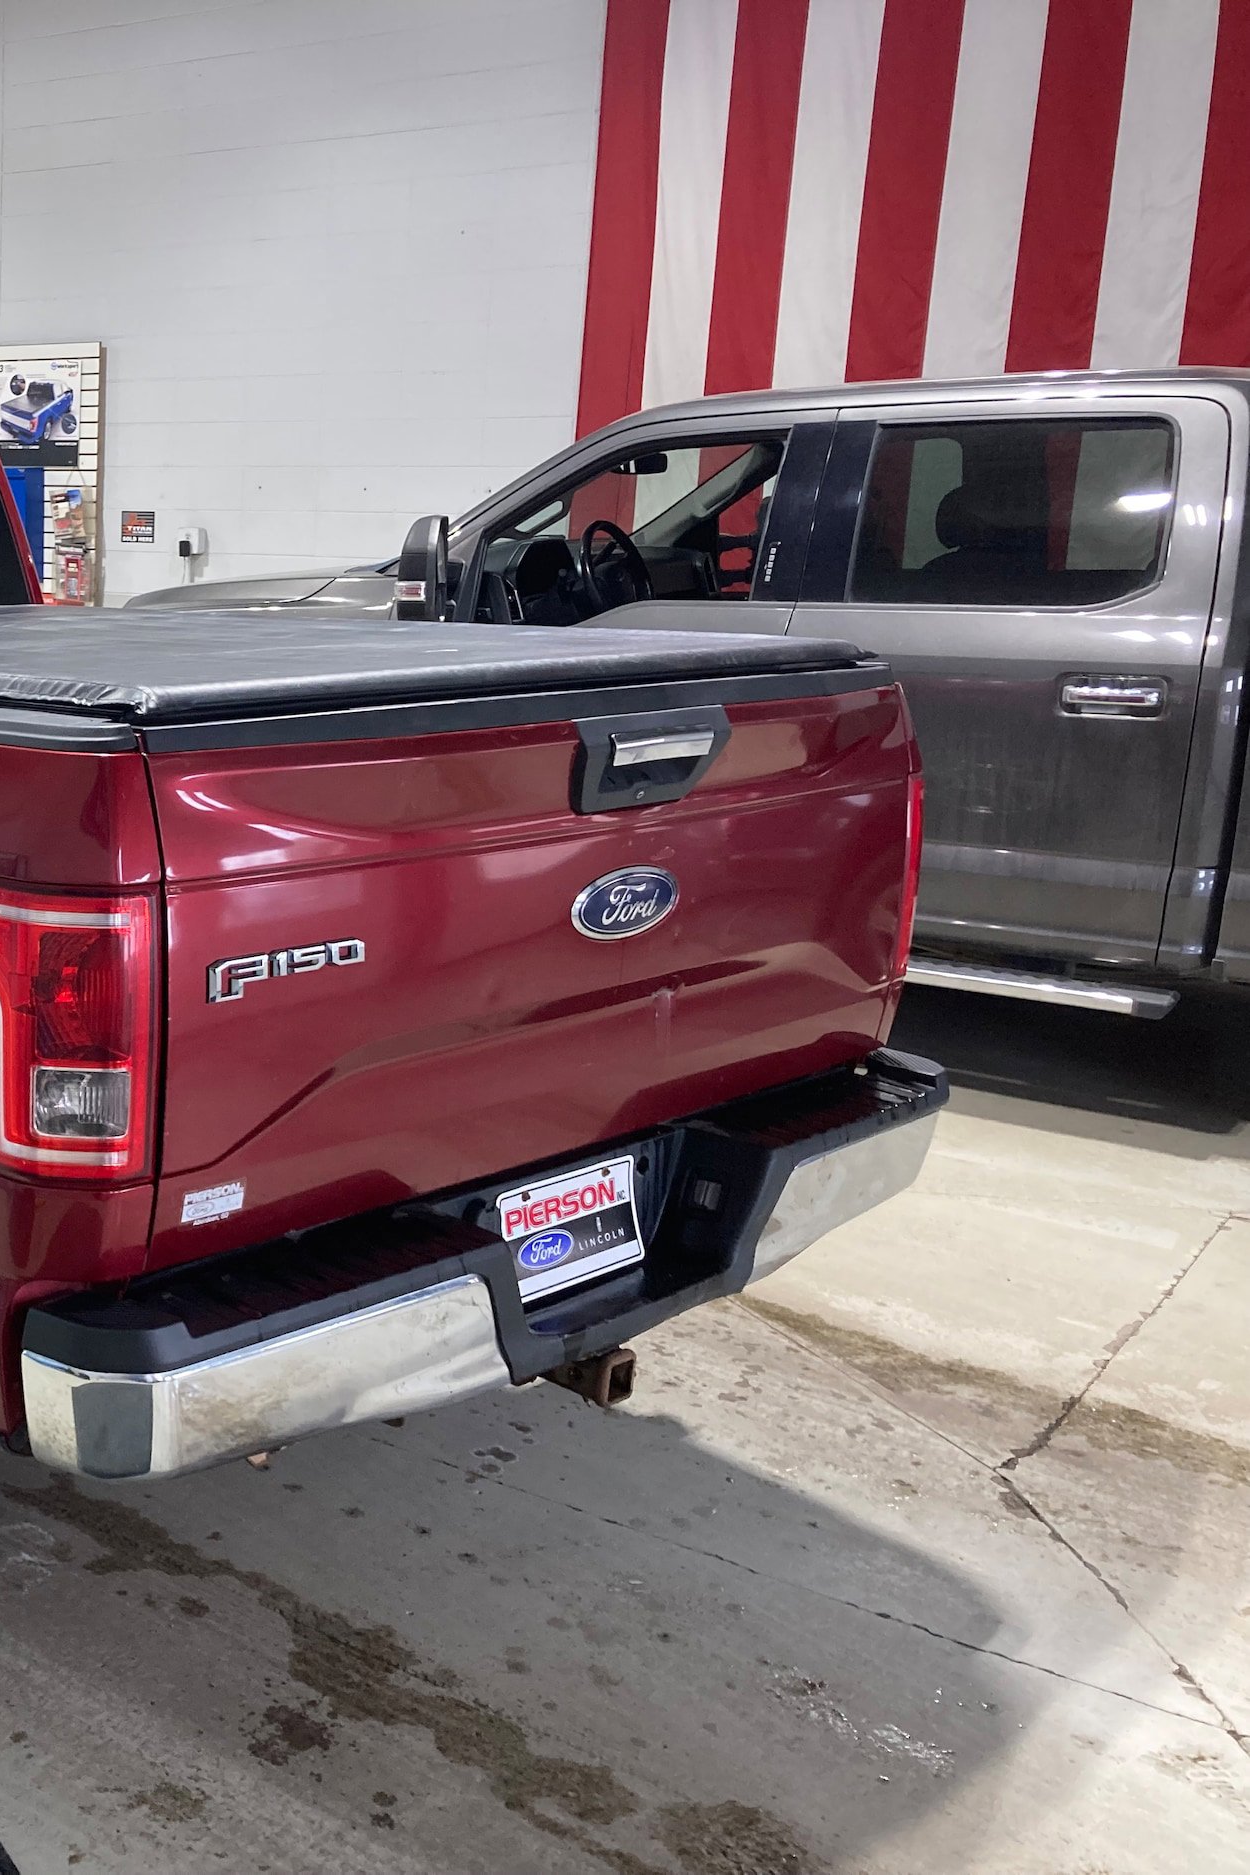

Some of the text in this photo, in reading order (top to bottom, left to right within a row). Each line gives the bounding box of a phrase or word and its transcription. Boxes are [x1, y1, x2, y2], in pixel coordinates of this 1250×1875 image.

[601, 882, 660, 926] Ford
[505, 1177, 617, 1237] PIERSON
[530, 1227, 625, 1264] Ford LINCOLN
